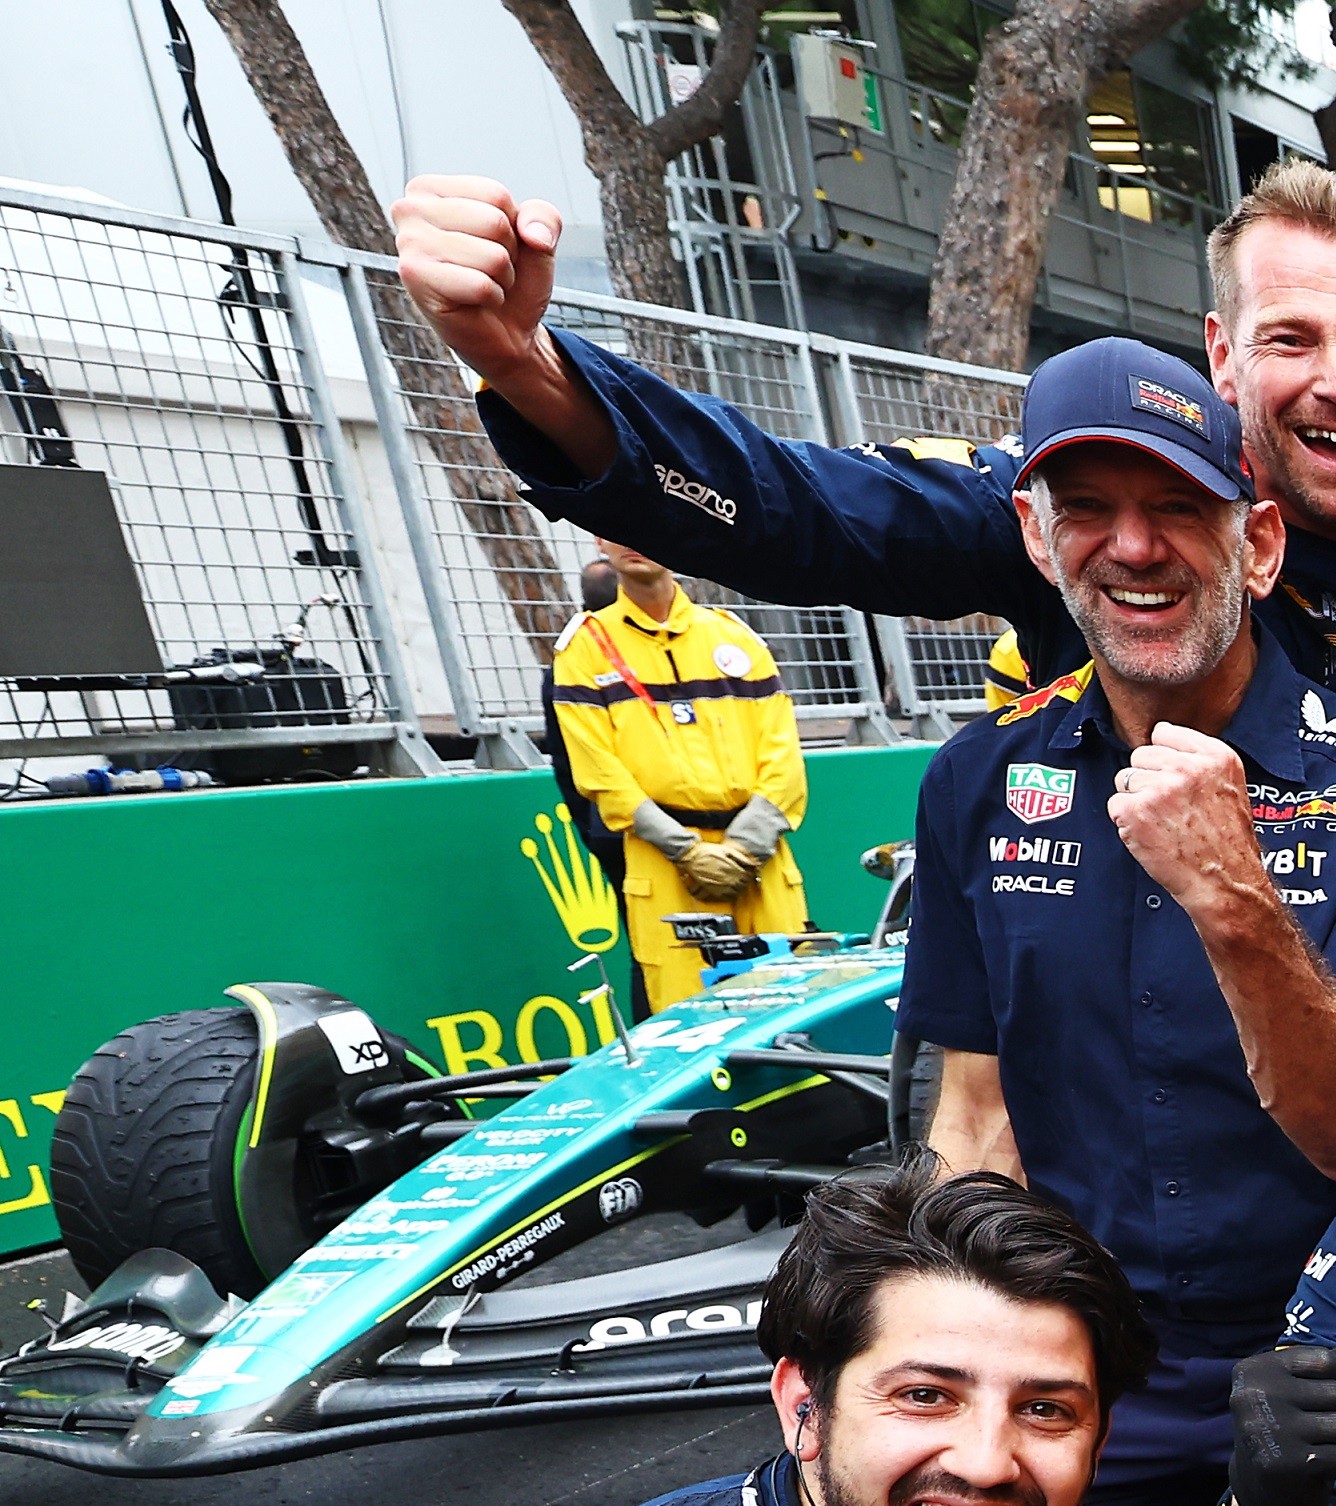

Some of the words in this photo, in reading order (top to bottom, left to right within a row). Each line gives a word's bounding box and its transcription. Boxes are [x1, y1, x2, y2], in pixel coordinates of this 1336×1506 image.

[1138, 381, 1201, 413] ORACLE
[1140, 400, 1203, 430] RACING
[1011, 766, 1070, 793] TAG
[1008, 789, 1068, 820] HEUER
[989, 836, 1049, 864] Mobil
[1262, 842, 1327, 877] YBIT
[992, 876, 1076, 895] ORACLE
[452, 1212, 565, 1290] GIRARD-PERREGAUX
